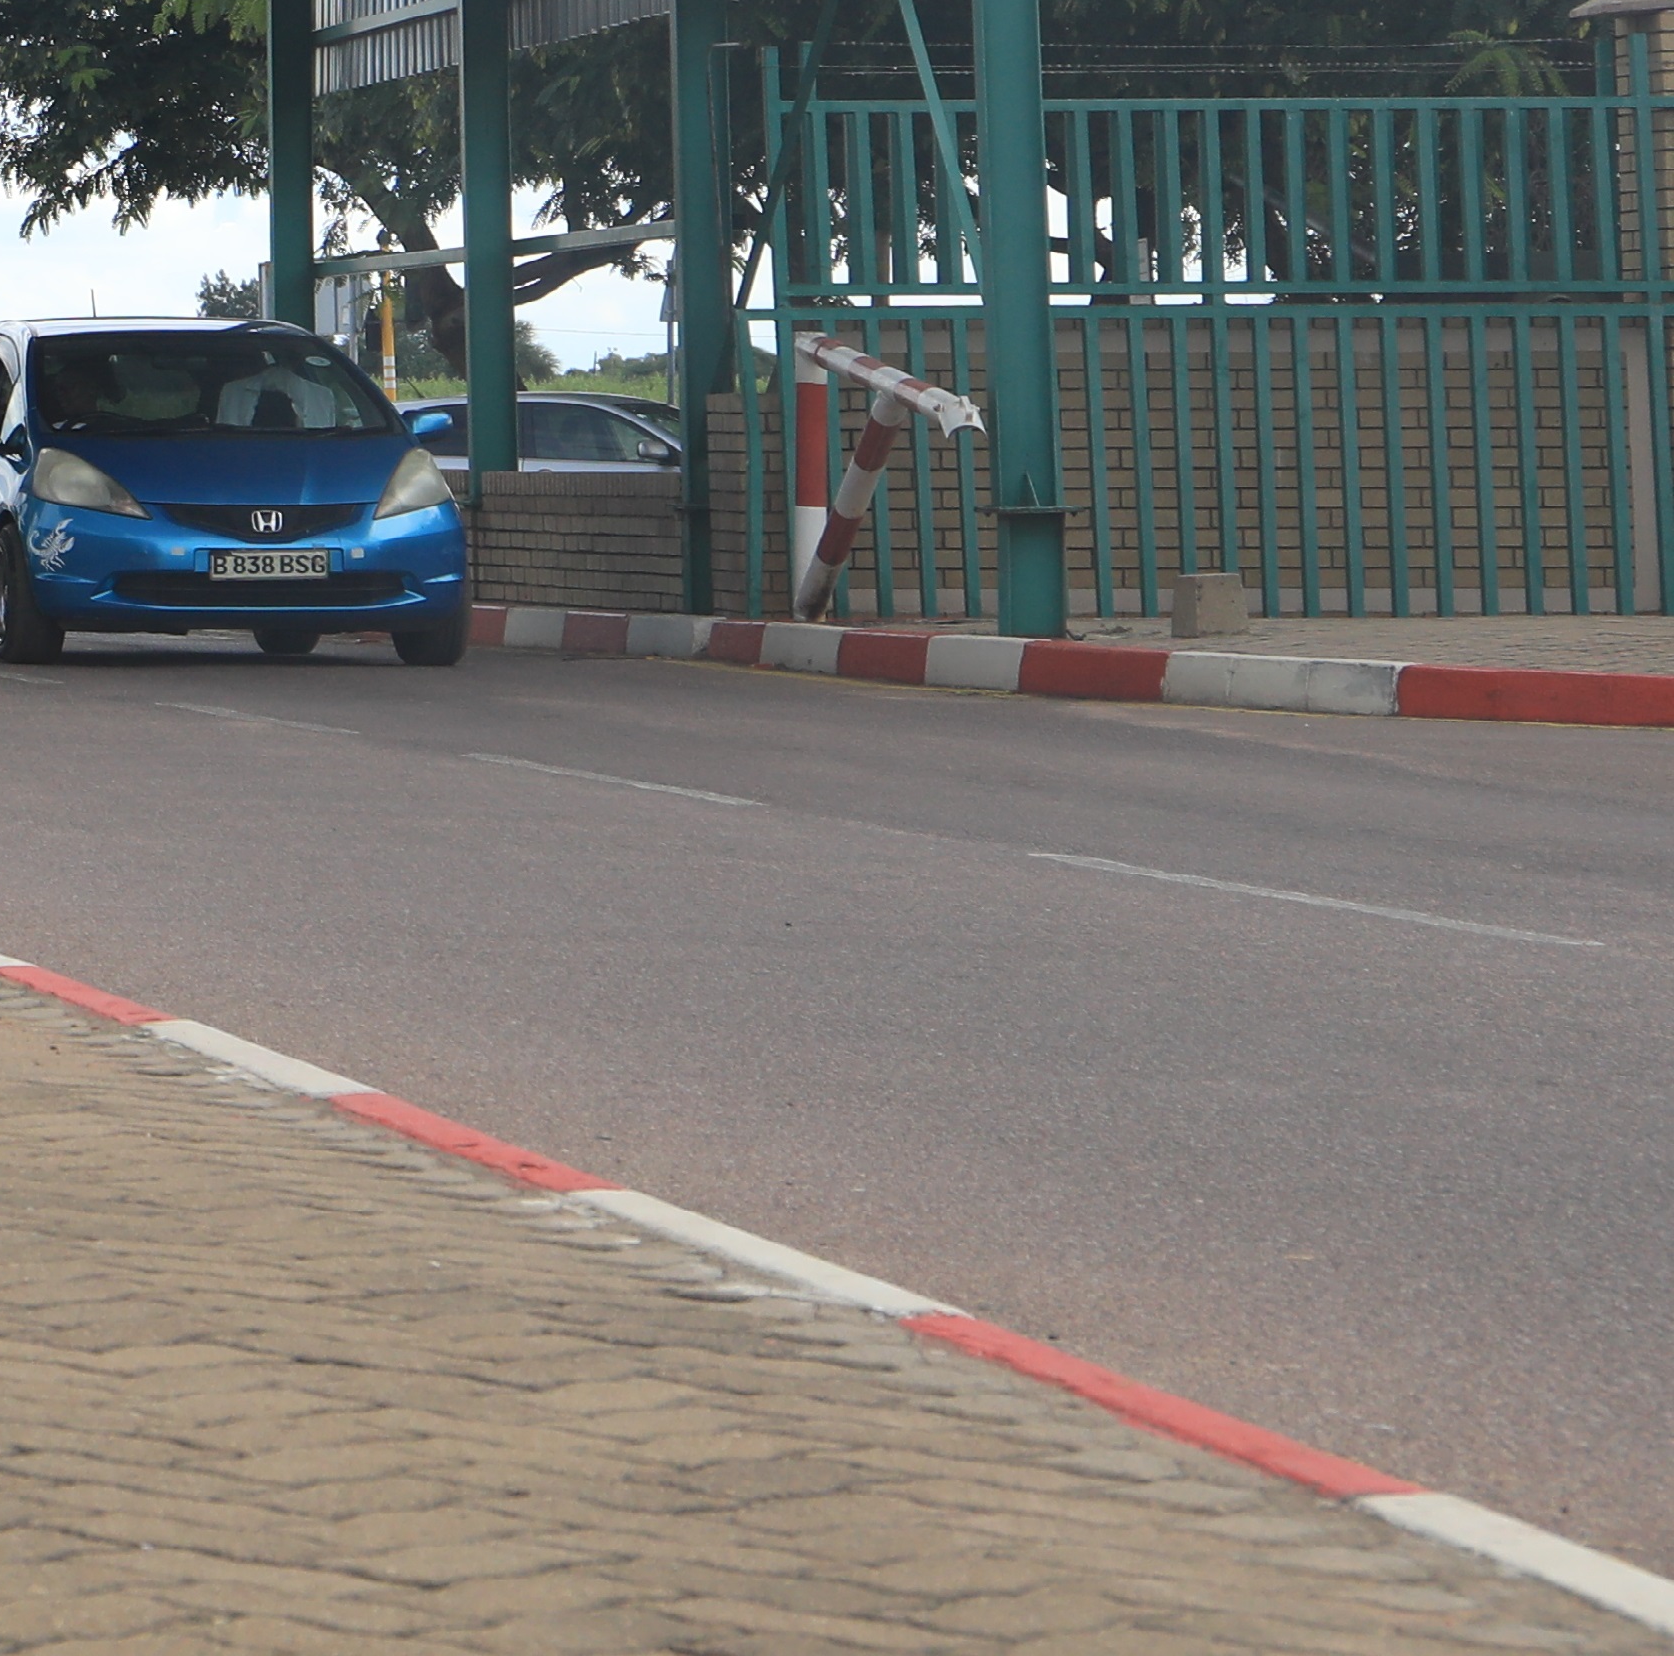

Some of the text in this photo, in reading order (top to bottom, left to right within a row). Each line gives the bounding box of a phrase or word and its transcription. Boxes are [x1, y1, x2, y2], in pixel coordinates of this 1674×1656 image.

[213, 554, 326, 575] B 838 BSG
